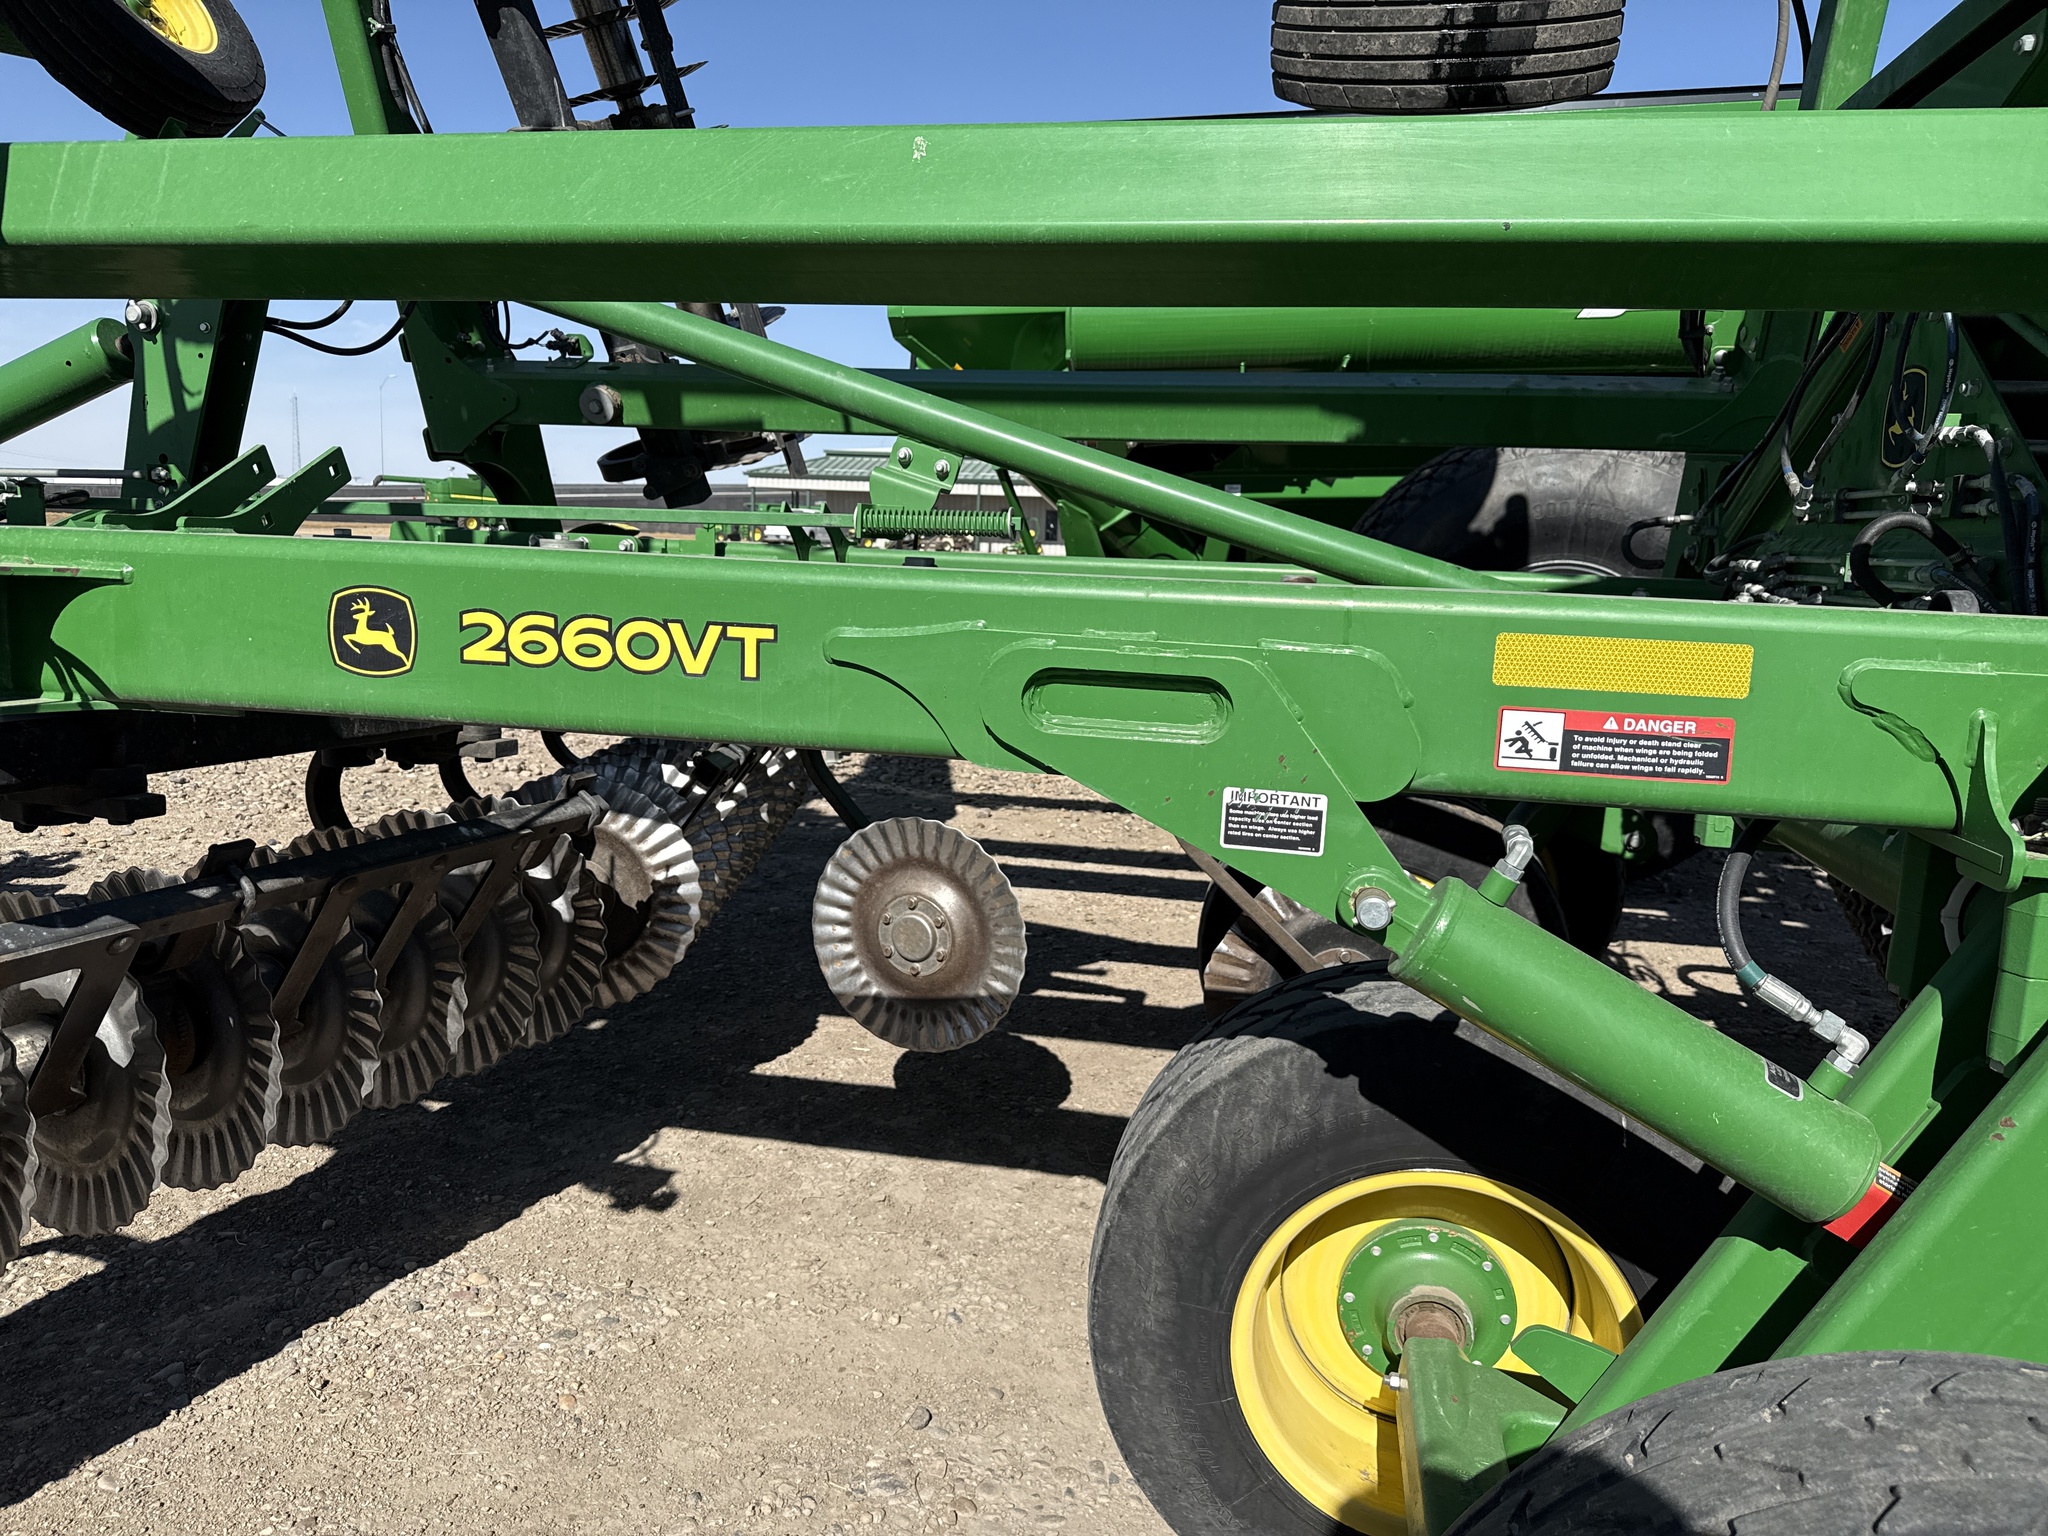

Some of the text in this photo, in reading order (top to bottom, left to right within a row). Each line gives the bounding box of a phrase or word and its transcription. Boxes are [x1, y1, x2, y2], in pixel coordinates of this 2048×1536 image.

[459, 608, 777, 681] 2660VT
[1623, 718, 1697, 734] DANGER
[1573, 734, 1583, 742] To
[1606, 736, 1628, 745] injury
[1661, 740, 1682, 748] stand
[1683, 741, 1702, 749] clear
[1582, 744, 1613, 752] machine
[1635, 748, 1657, 756] wings
[1672, 749, 1693, 758] being
[1694, 750, 1719, 758] folded
[1581, 752, 1616, 761] unfolded.
[1617, 754, 1659, 763] Mechanical
[1669, 757, 1704, 766] hydraulic
[1571, 760, 1594, 768] failure
[1610, 762, 1630, 770] allow
[1632, 764, 1653, 773] wings
[1677, 767, 1705, 776] rapidly.
[1228, 816, 1251, 824] capacity
[1274, 818, 1292, 826] center
[1298, 828, 1316, 836] higher
